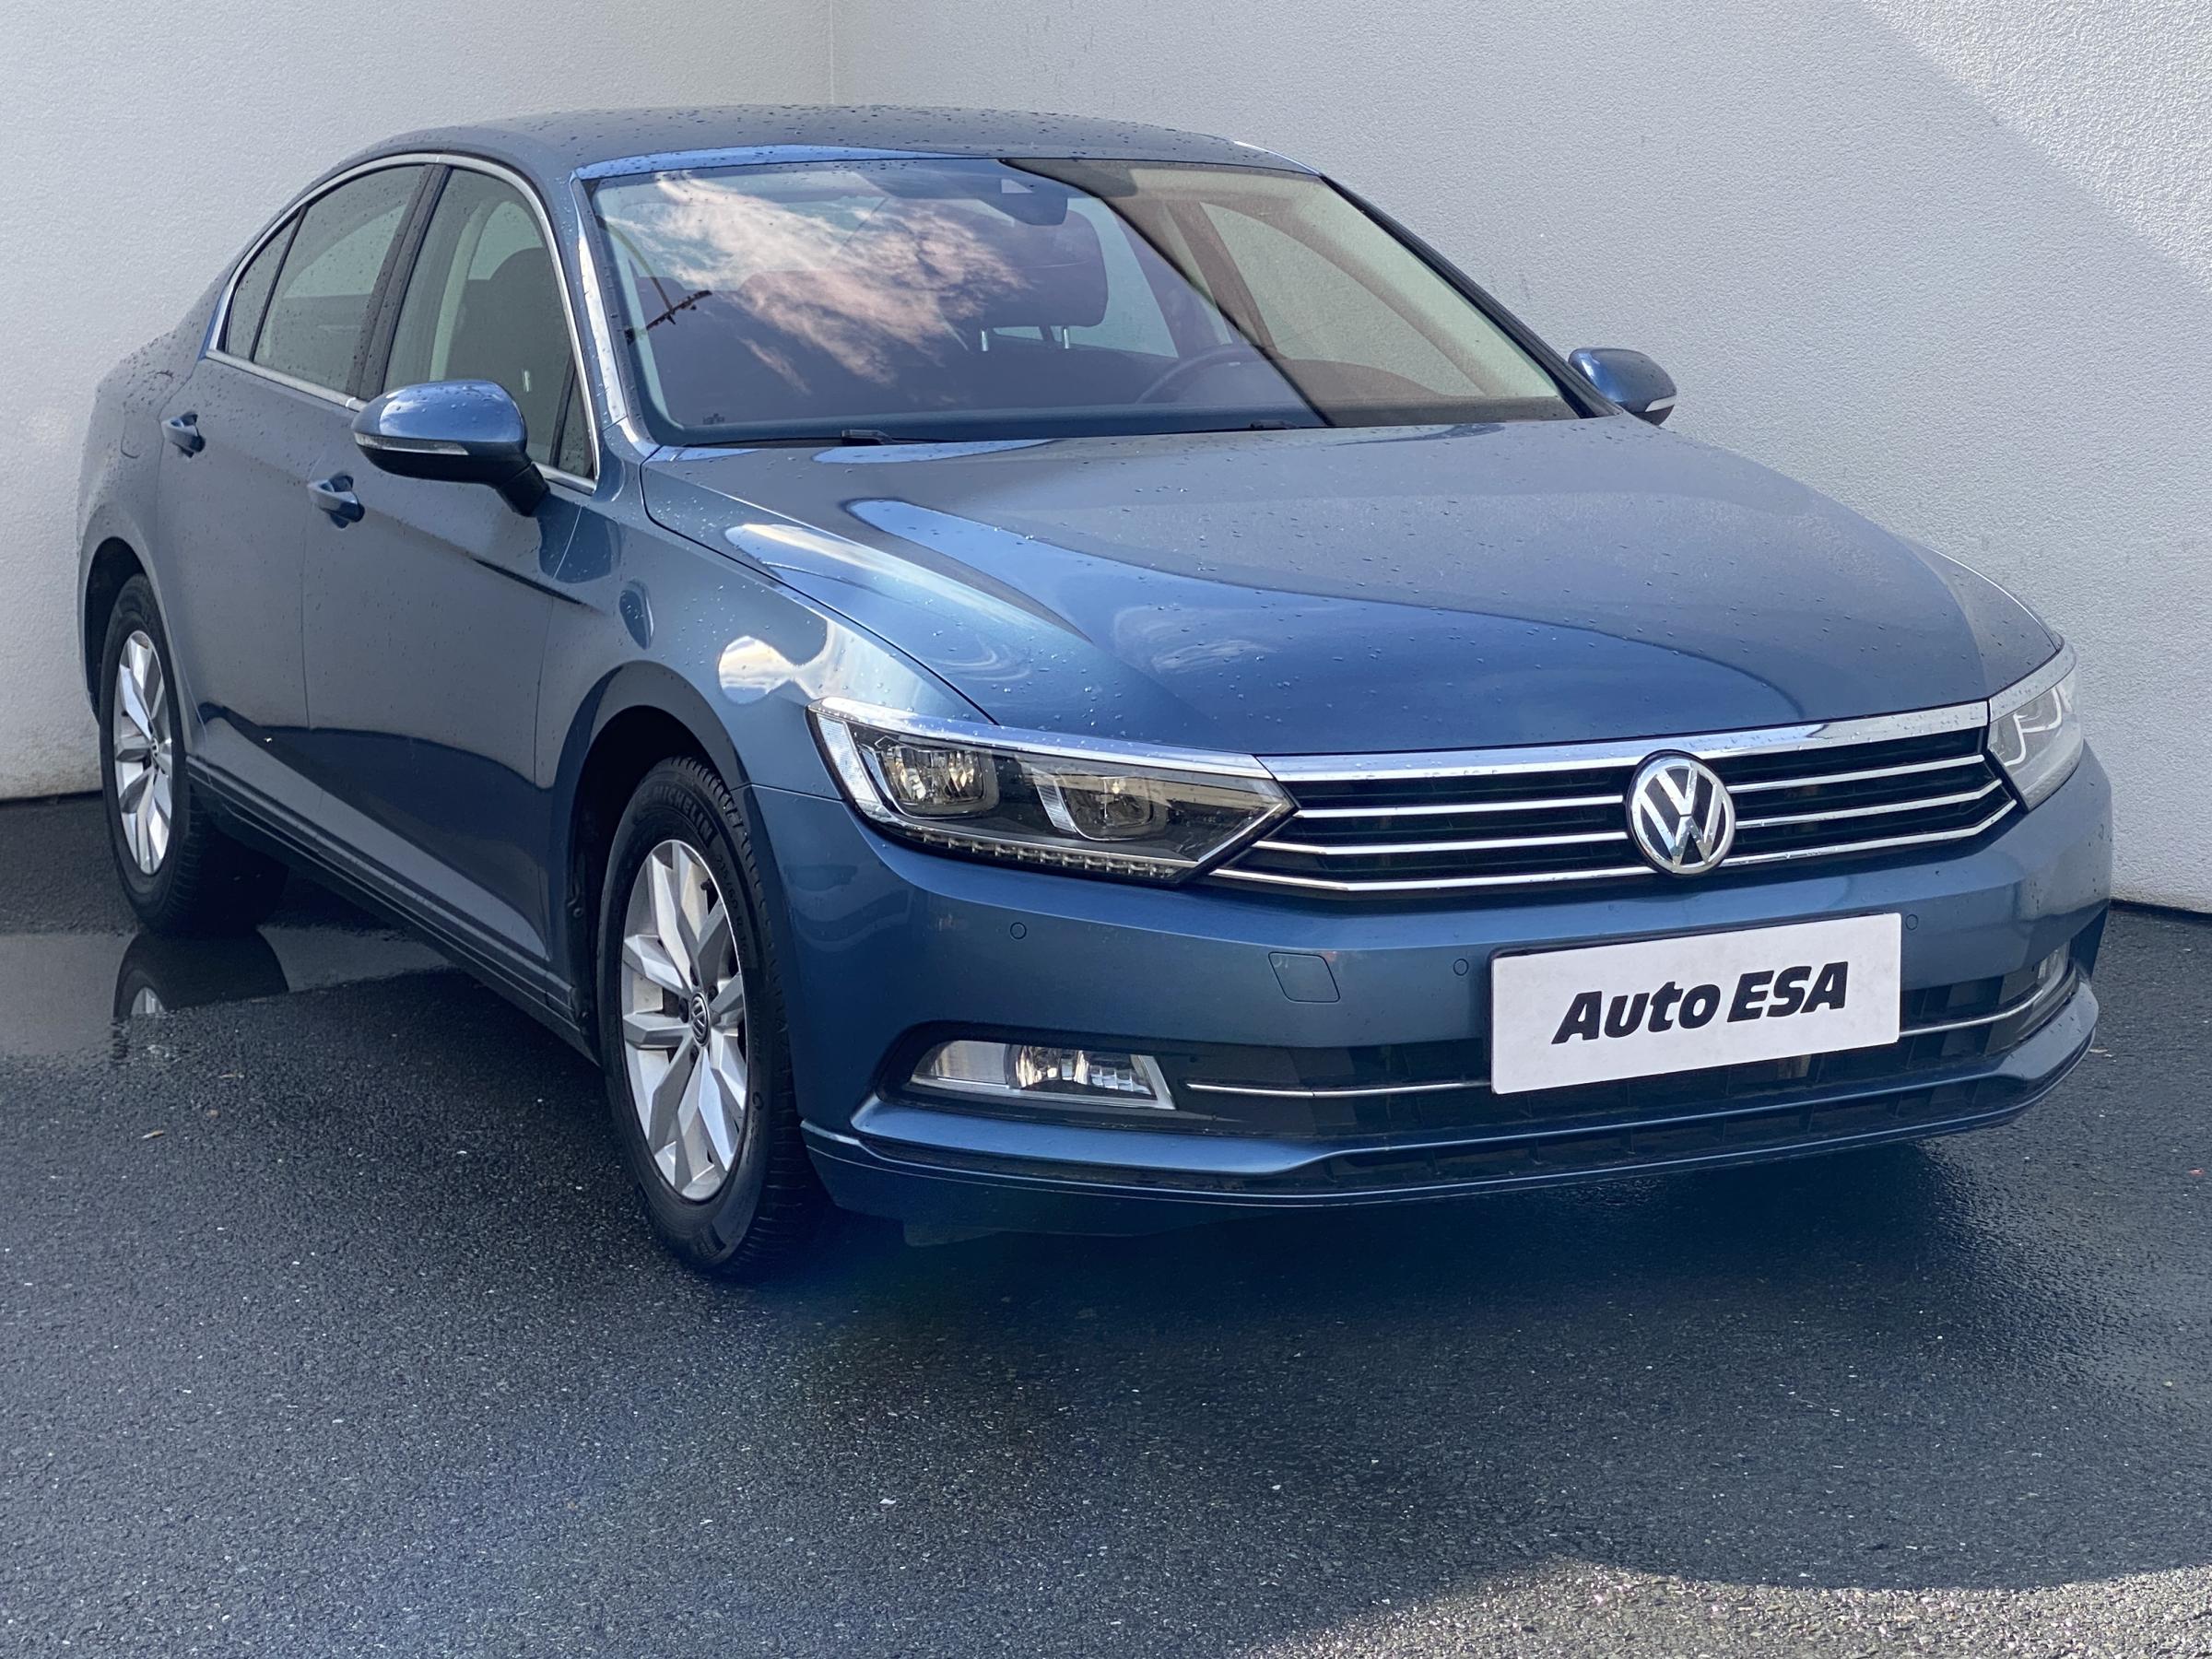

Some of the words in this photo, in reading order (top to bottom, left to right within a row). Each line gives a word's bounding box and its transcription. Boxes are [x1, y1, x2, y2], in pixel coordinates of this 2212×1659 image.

[653, 785, 714, 844] MICHELIN
[1633, 757, 1734, 873] VW
[1551, 981, 1722, 1044] Auto
[1726, 961, 1849, 1023] ESA
